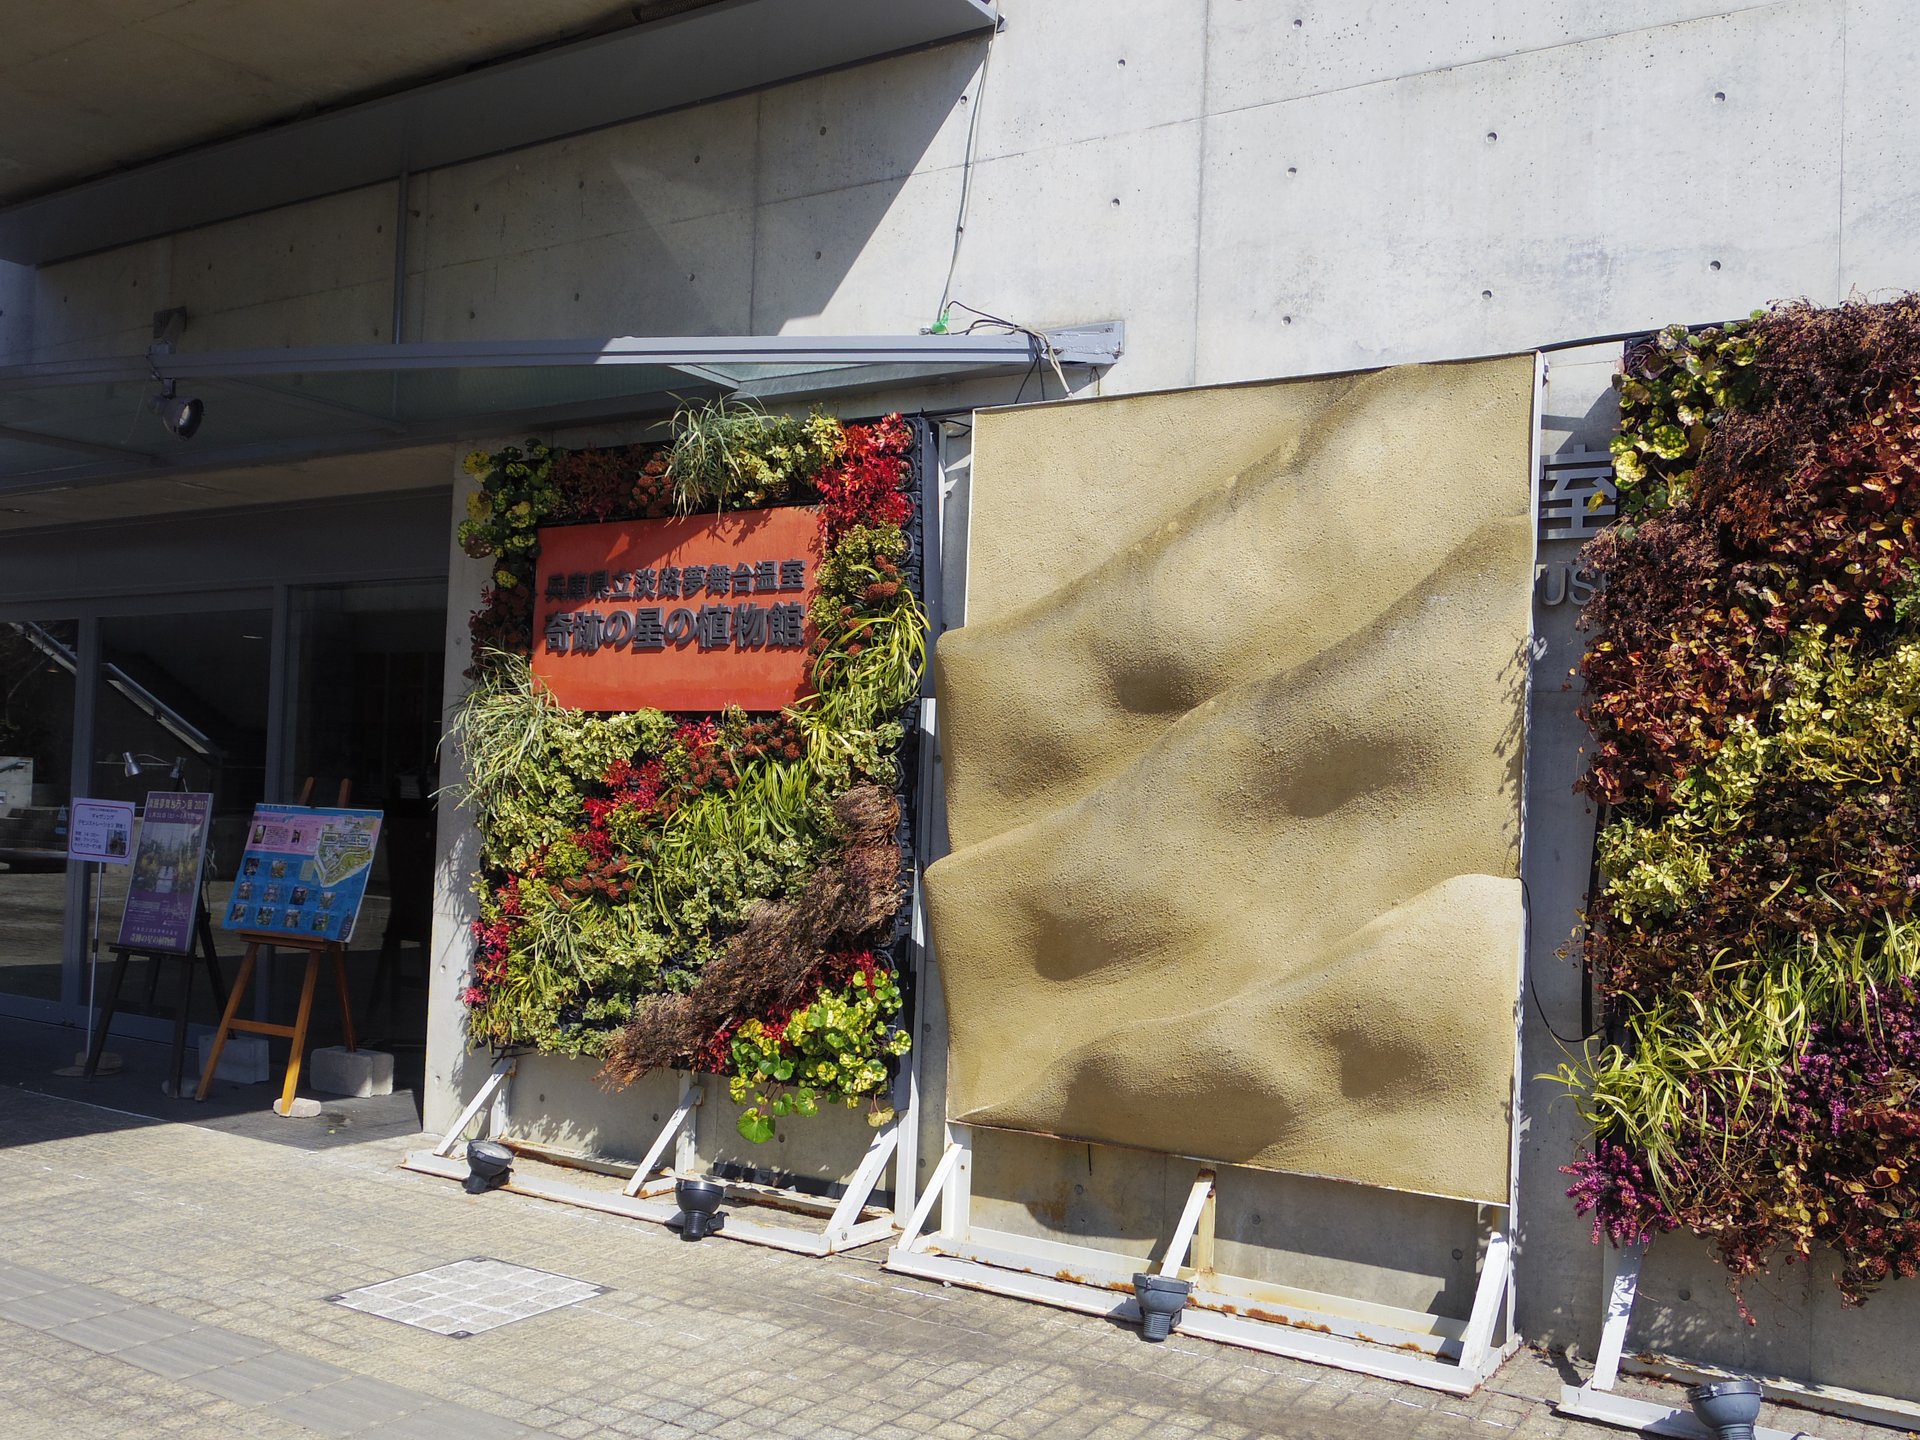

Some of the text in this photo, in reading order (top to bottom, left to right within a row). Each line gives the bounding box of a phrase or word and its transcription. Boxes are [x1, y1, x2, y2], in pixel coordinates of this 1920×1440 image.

[545, 559, 806, 602] 兵庫県立淡路夢舞台温室
[544, 601, 806, 653] 奇跡の星の植物館
